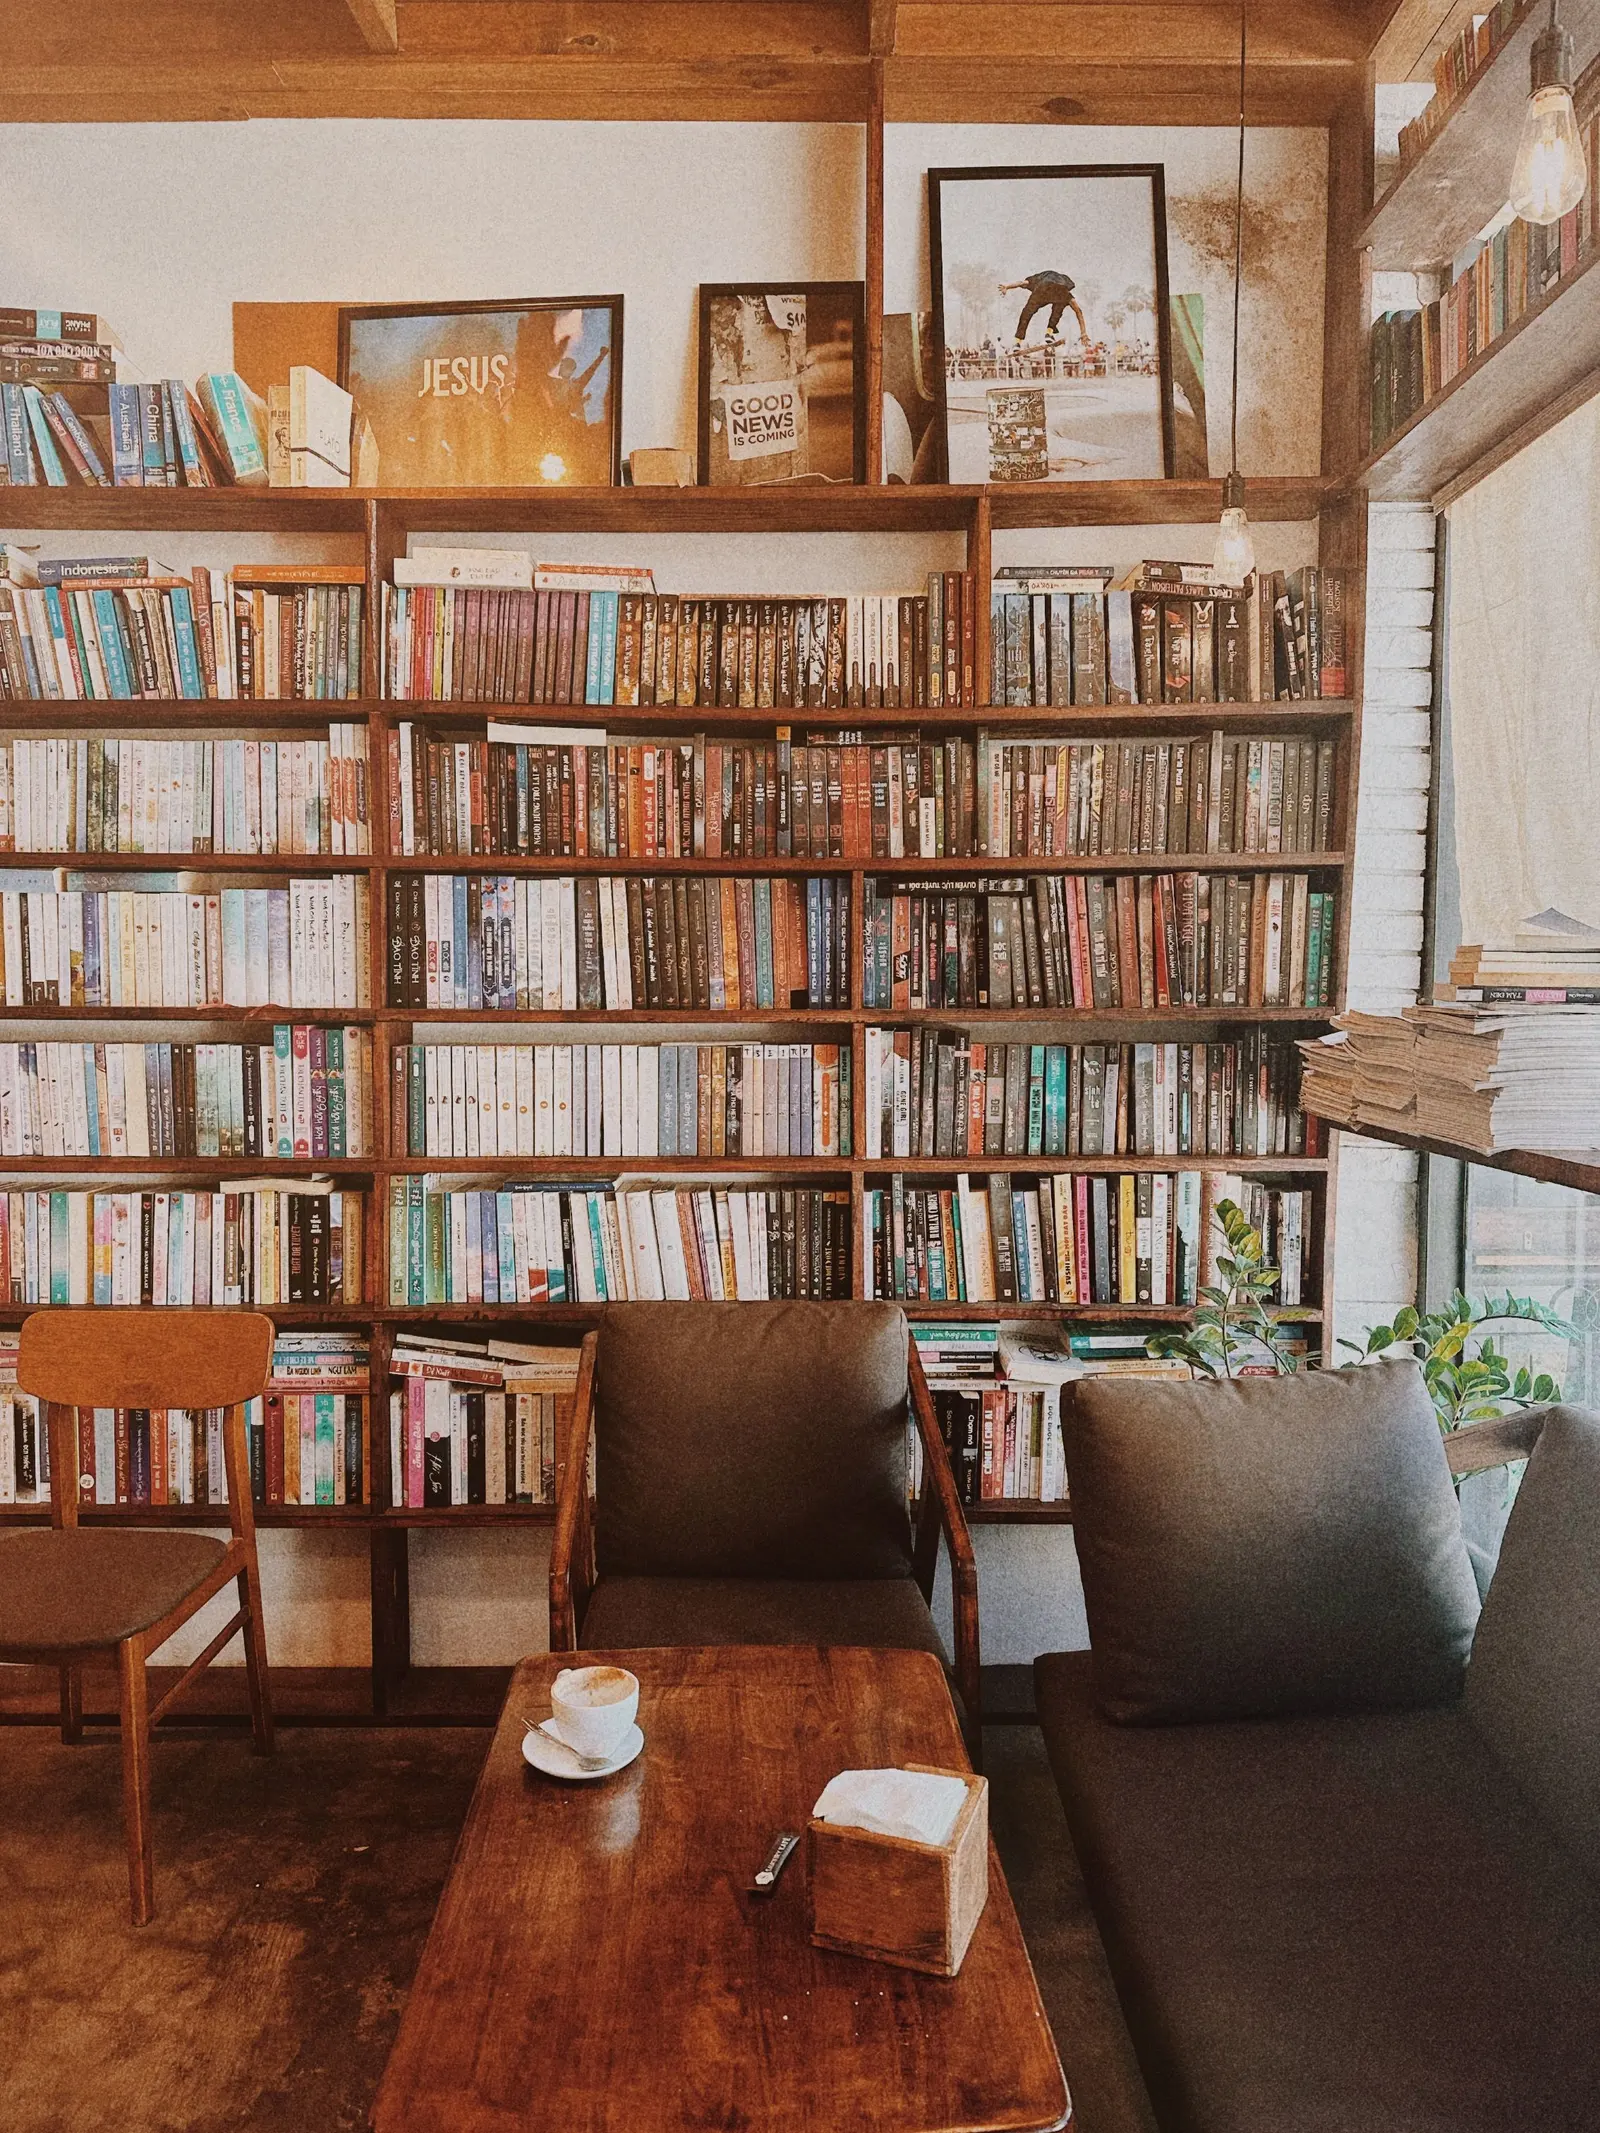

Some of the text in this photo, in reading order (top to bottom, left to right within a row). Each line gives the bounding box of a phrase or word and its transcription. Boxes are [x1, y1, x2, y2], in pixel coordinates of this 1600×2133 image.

[418, 355, 510, 398] JESUS
[222, 389, 242, 433] France
[730, 393, 794, 416] GOOD
[10, 406, 25, 457] Thailand
[52, 416, 67, 438] Laos
[65, 417, 90, 454] Cambodia
[120, 402, 131, 452] Australia
[147, 404, 159, 443] China
[732, 412, 794, 435] NEWS
[734, 429, 795, 446] IS COMING
[61, 563, 119, 577] Indonesia
